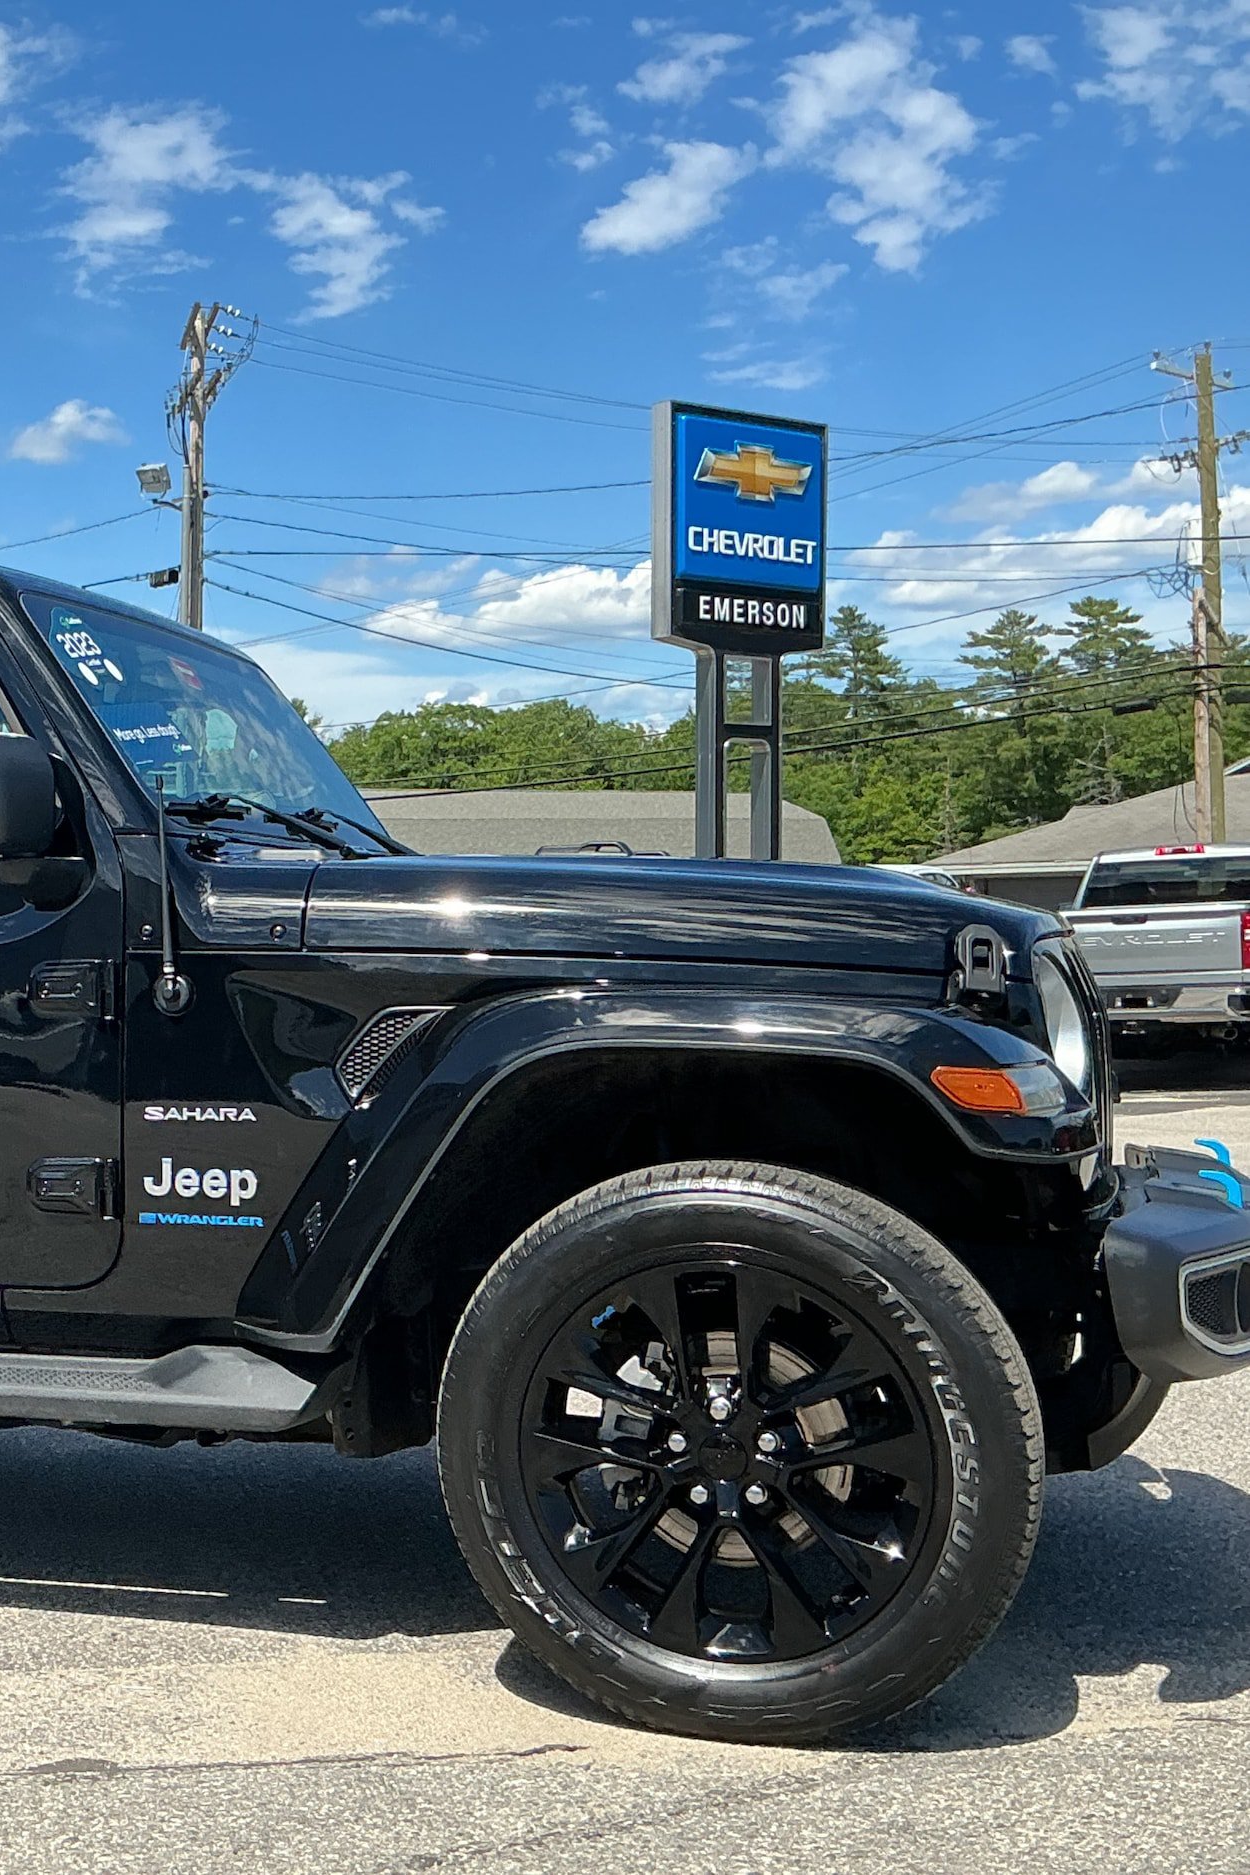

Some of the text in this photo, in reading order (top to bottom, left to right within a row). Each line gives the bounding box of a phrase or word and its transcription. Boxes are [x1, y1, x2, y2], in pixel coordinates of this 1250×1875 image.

[688, 525, 817, 565] CHEVROLET
[699, 595, 805, 629] EMERSON
[56, 631, 102, 658] 2023
[112, 727, 136, 741] More
[143, 1106, 257, 1122] SAHARA
[143, 1157, 258, 1206] Jeep
[156, 1213, 265, 1228] WRANGLER
